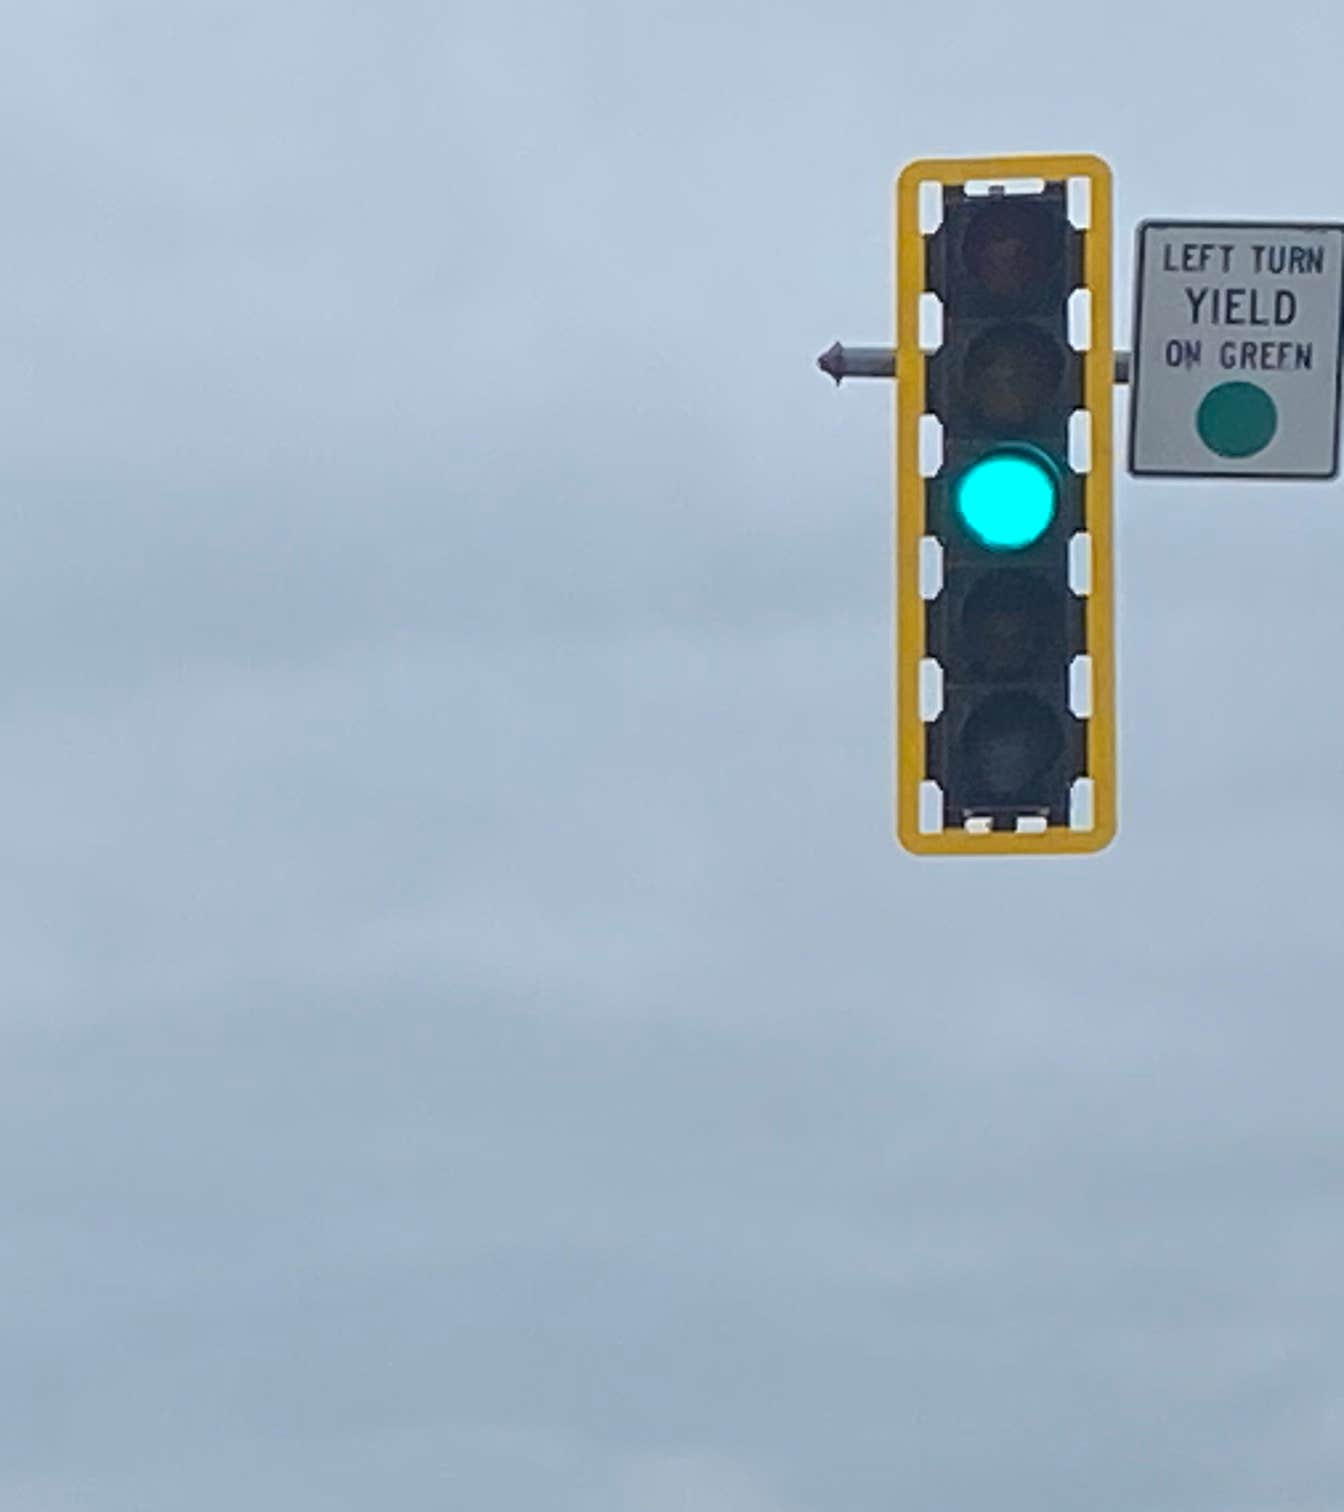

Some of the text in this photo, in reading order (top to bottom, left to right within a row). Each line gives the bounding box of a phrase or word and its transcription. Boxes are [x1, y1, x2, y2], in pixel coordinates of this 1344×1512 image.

[1163, 243, 1325, 275] LEFT TURN
[1185, 286, 1298, 327] YIELD
[1165, 338, 1315, 371] ON GREEN
